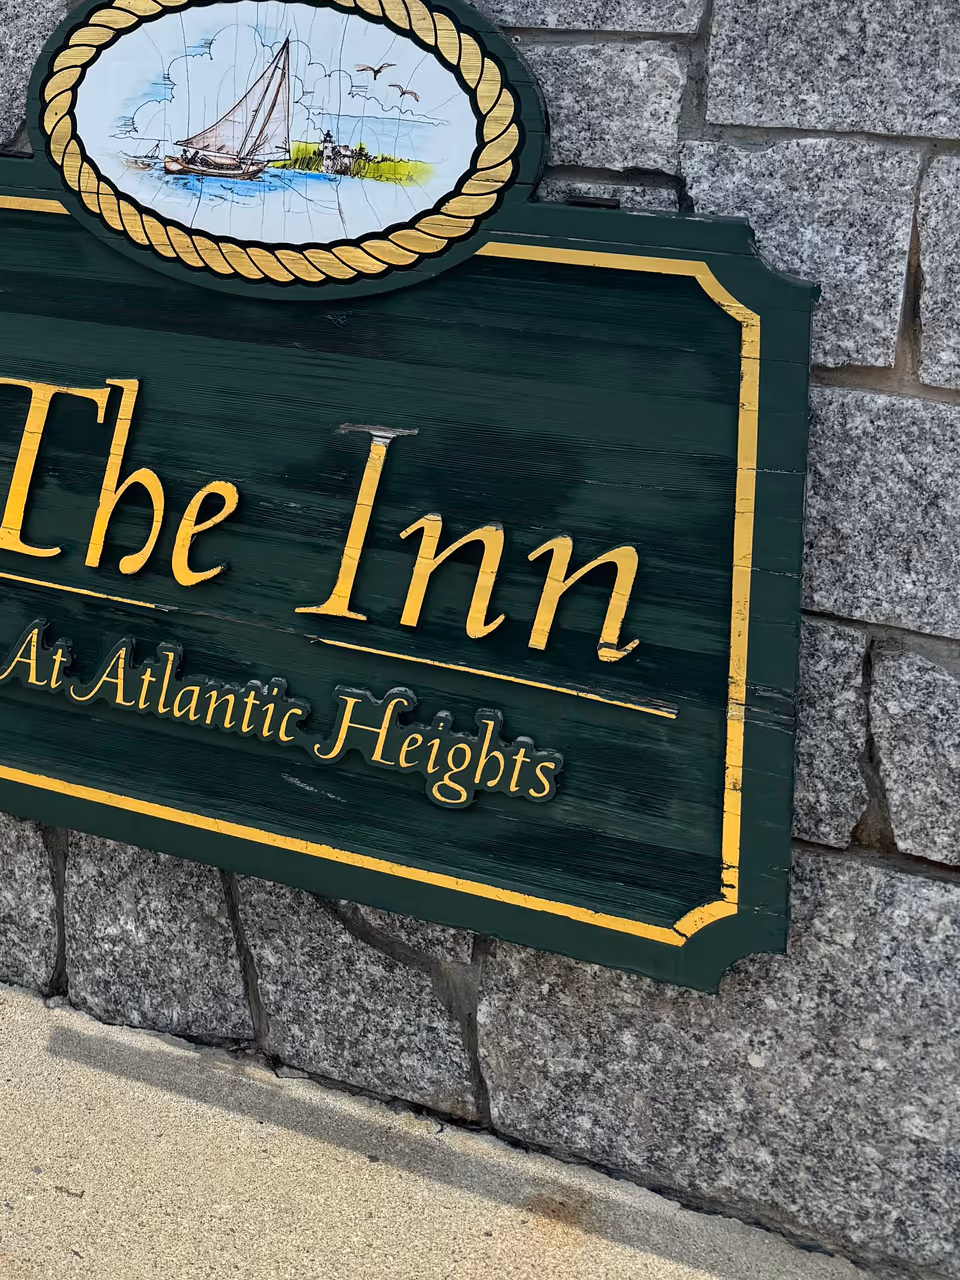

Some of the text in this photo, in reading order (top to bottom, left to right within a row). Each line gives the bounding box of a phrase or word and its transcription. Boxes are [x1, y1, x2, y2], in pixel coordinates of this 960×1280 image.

[295, 423, 640, 662] Inn
[70, 648, 303, 742] Atlantic
[313, 695, 556, 804] Heights
